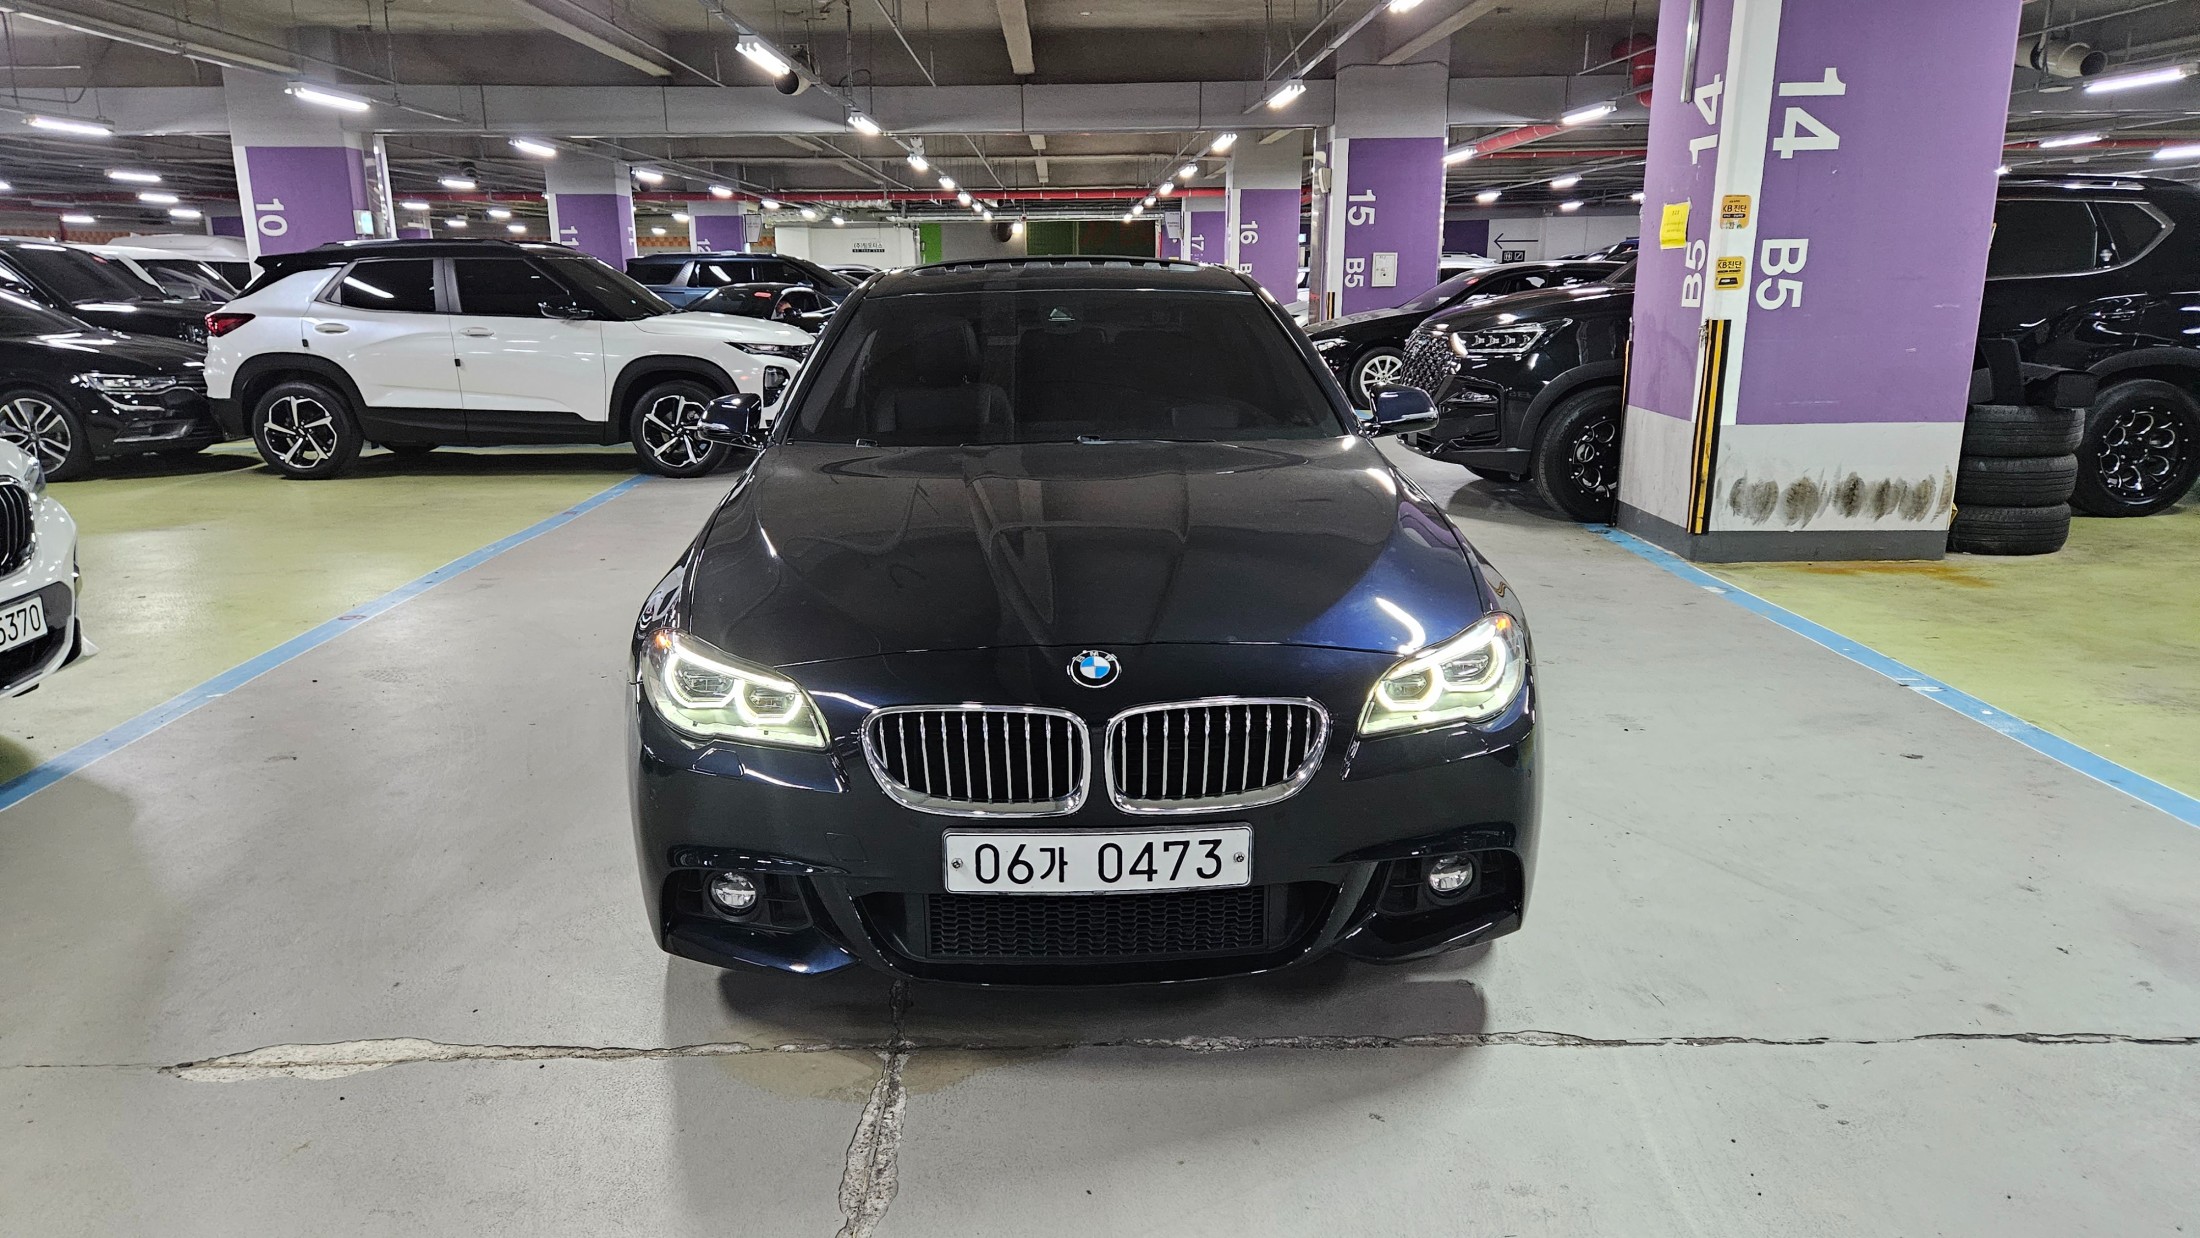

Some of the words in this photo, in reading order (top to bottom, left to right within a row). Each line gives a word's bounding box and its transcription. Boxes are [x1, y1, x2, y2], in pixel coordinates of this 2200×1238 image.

[1689, 73, 1724, 165] 14
[1773, 67, 1846, 159] 14
[256, 198, 288, 236] 10
[1347, 189, 1376, 226] 15
[560, 225, 579, 246] 11
[1191, 234, 1205, 251] 17
[1240, 220, 1259, 245] 16
[1240, 263, 1252, 277] B
[1344, 258, 1365, 288] B5
[1681, 240, 1706, 308] B5
[1755, 238, 1809, 310] B5
[1072, 649, 1118, 663] BMW
[974, 843, 1068, 884] 06가
[1097, 838, 1223, 884] 0473
